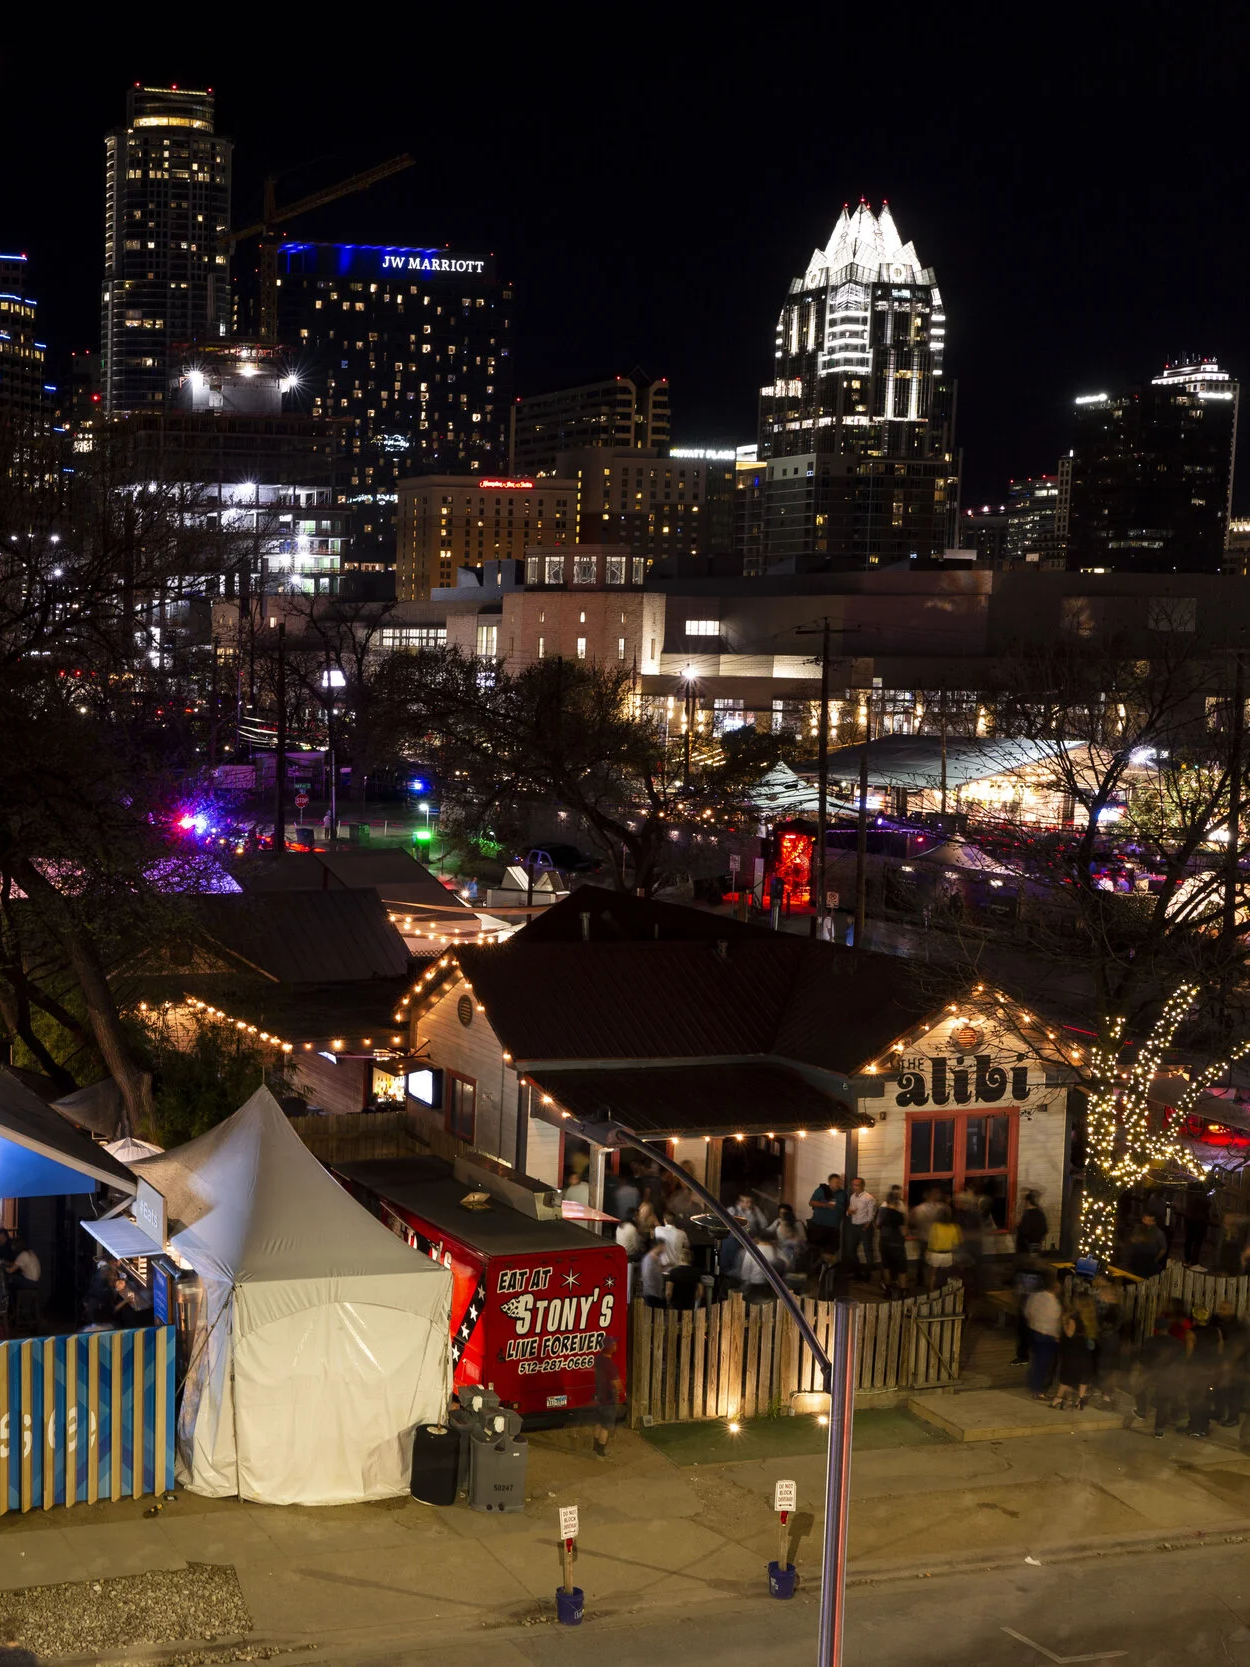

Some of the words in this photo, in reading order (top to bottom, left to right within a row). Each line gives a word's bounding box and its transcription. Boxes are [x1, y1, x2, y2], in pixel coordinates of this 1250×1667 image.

[382, 256, 405, 269] JW
[408, 258, 484, 273] MARRIOTT
[900, 1057, 925, 1072] THE
[896, 1054, 1032, 1107] alibi
[497, 1269, 526, 1293] EAT
[528, 1267, 553, 1291] AT
[514, 1287, 615, 1335] STONY'S
[506, 1339, 539, 1360] LIVE
[540, 1331, 605, 1358] FOREVER
[518, 1356, 595, 1375] 512-287-0666
